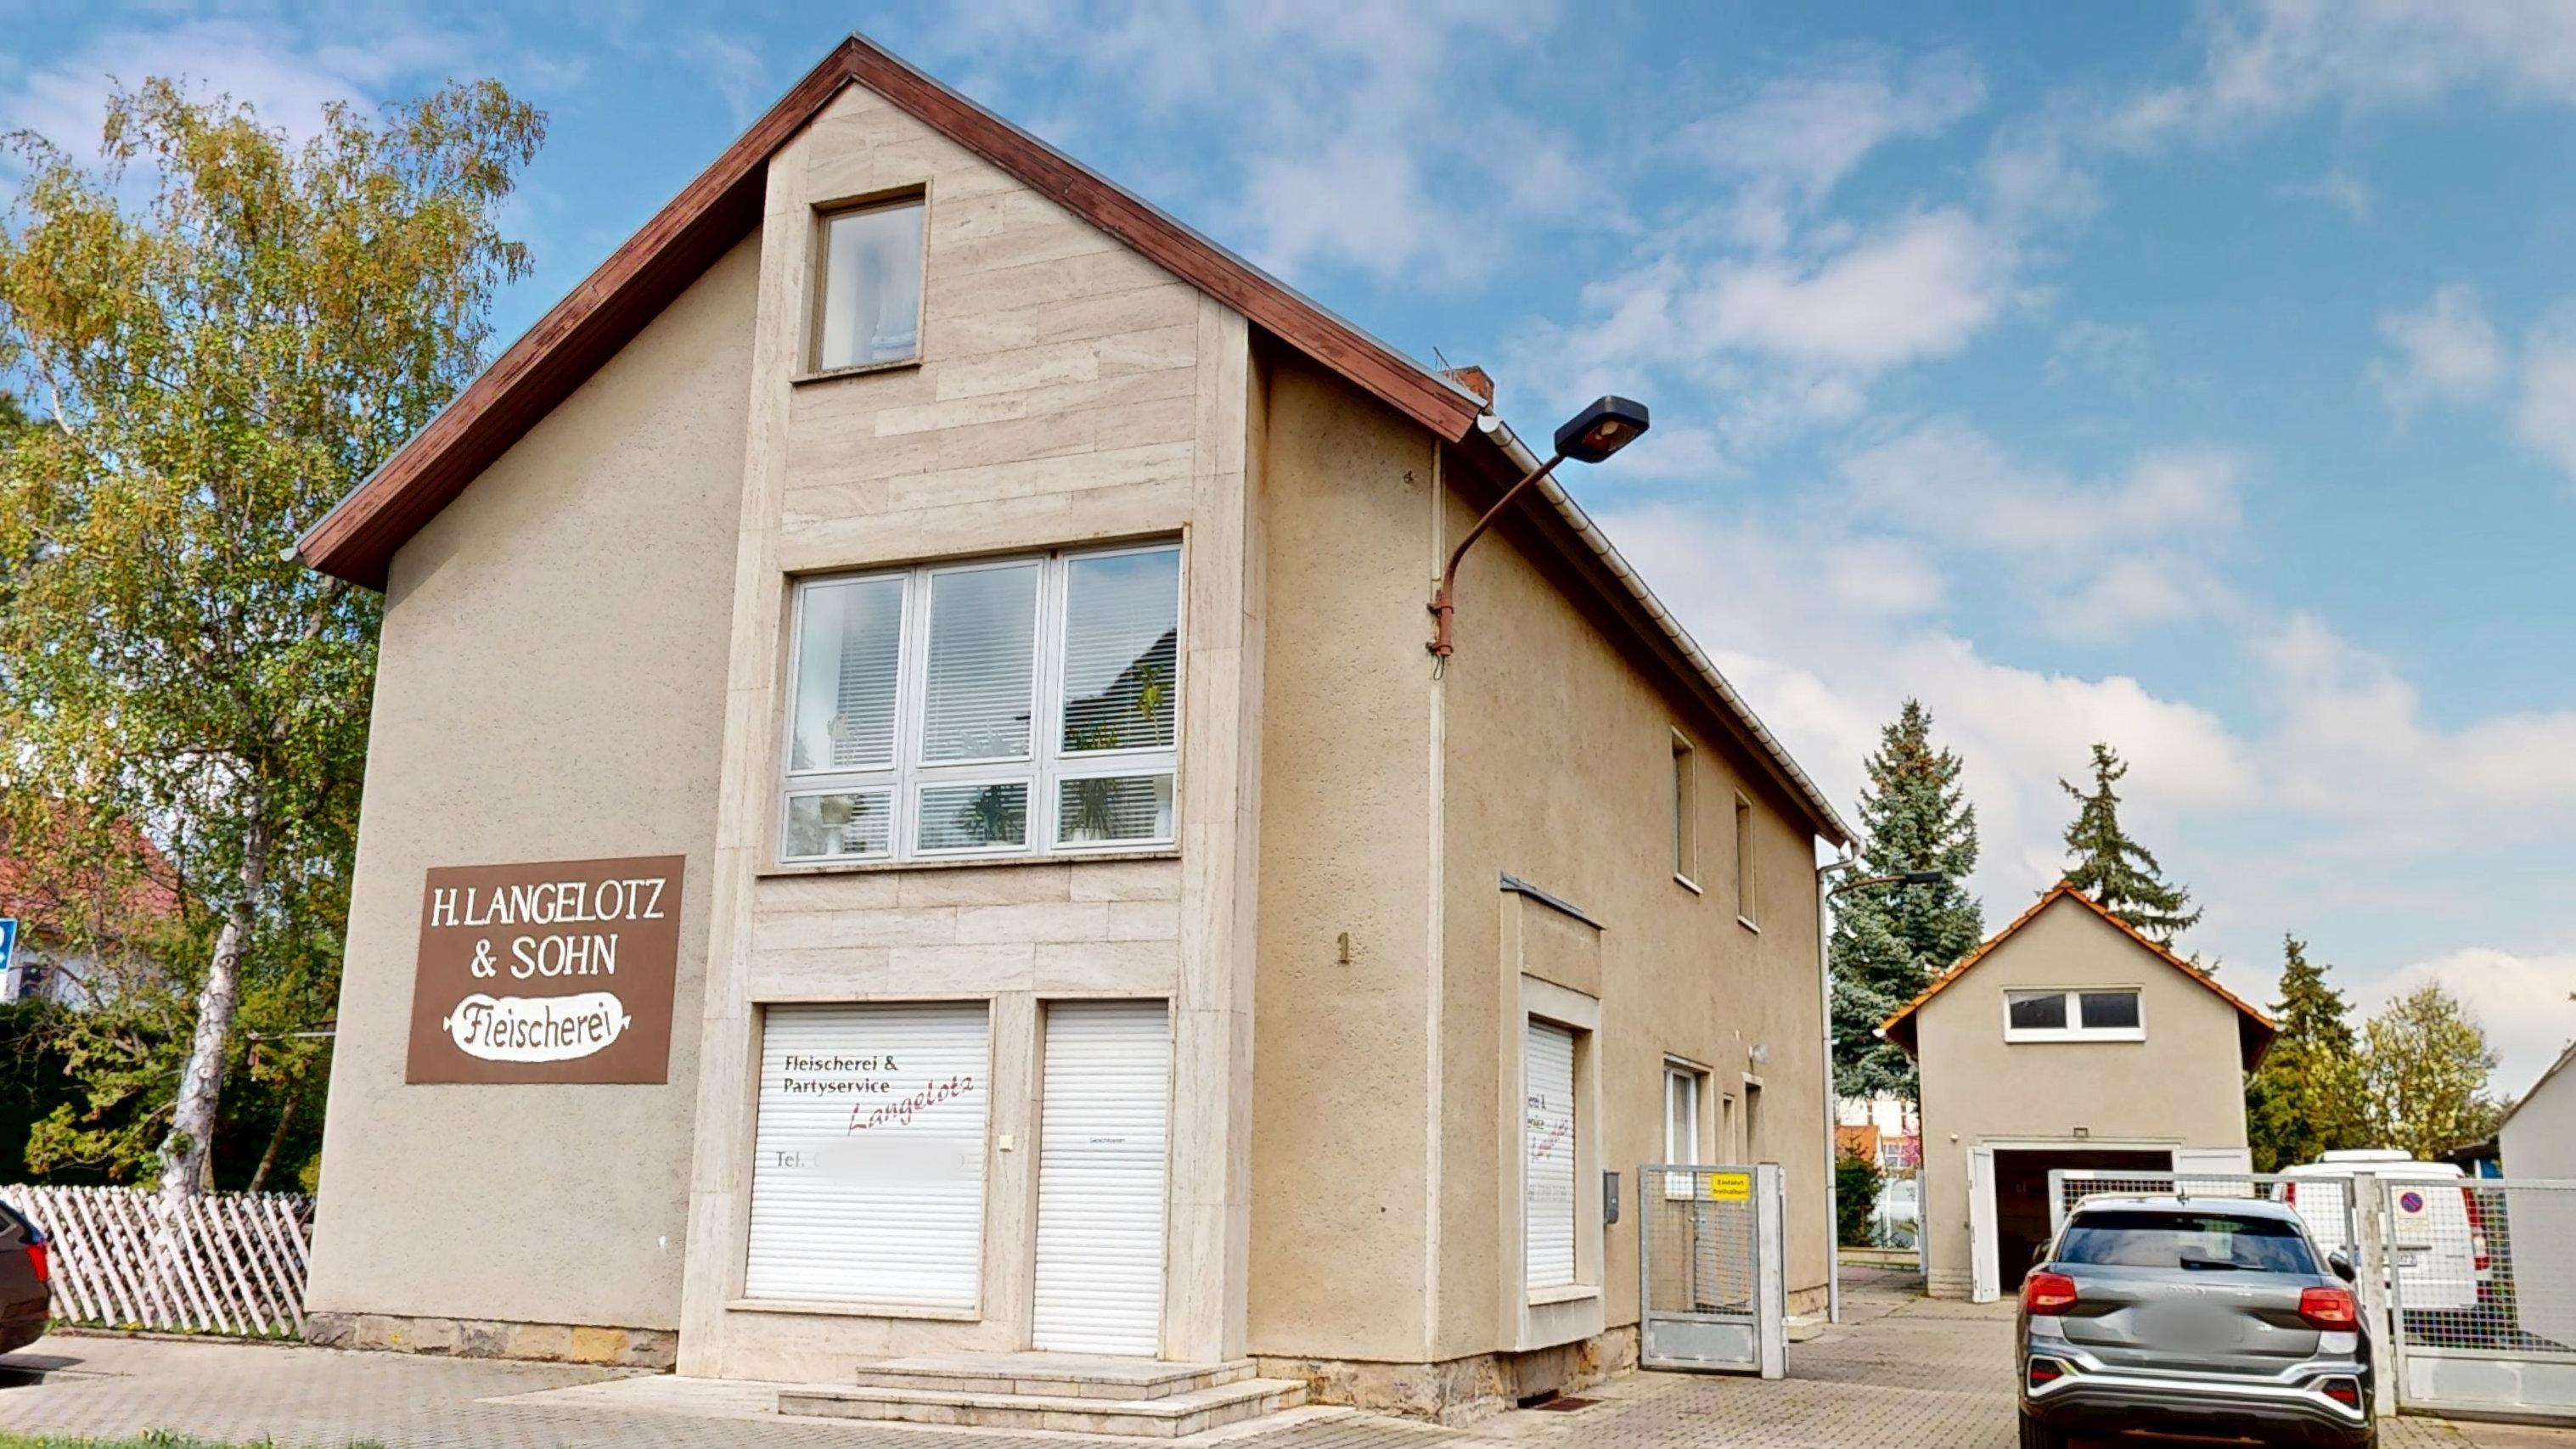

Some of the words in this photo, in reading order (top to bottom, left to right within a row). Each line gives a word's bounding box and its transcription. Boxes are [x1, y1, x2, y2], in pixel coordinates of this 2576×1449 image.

[470, 939, 497, 978] &
[510, 934, 619, 979] SOHN
[463, 1002, 612, 1048] Fleischerei
[785, 1056, 877, 1071] Fleischerei
[884, 1055, 899, 1071] &
[784, 1078, 891, 1097] Partyservice
[847, 1076, 974, 1137] Langelotz
[776, 1151, 805, 1168] Tel.
